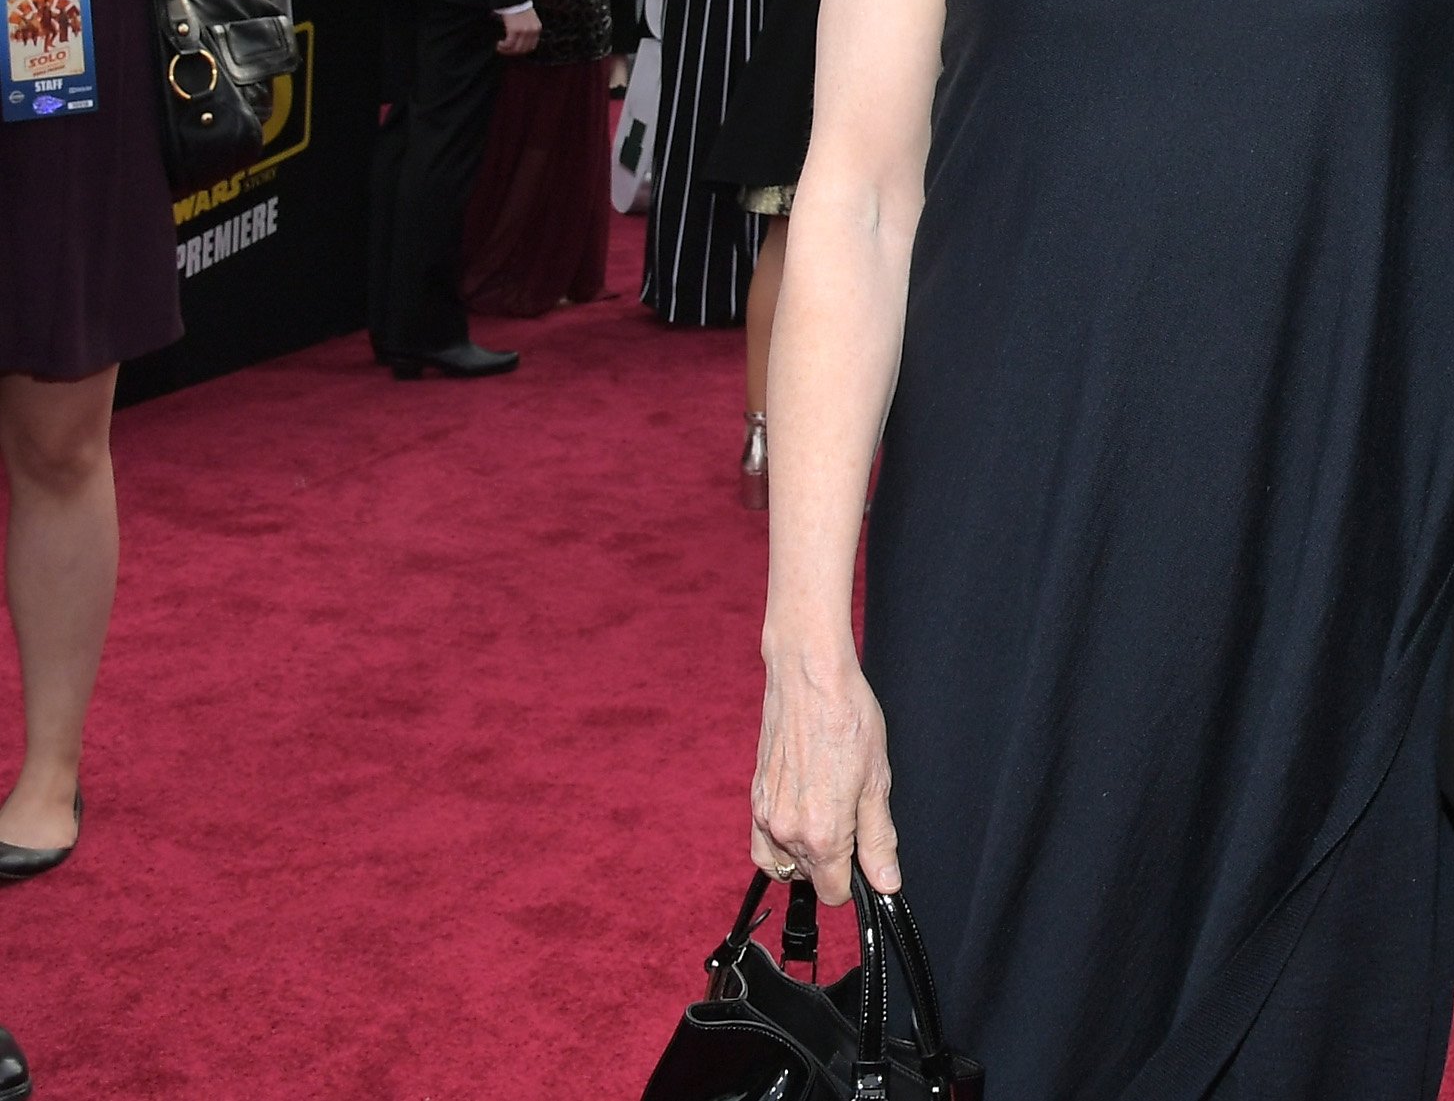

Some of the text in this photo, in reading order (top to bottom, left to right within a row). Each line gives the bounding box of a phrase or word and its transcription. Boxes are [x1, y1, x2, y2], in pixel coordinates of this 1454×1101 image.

[28, 50, 67, 69] SOLO
[34, 78, 63, 93] STAFF
[173, 170, 246, 226] WARS
[176, 196, 279, 279] PREMIERE
